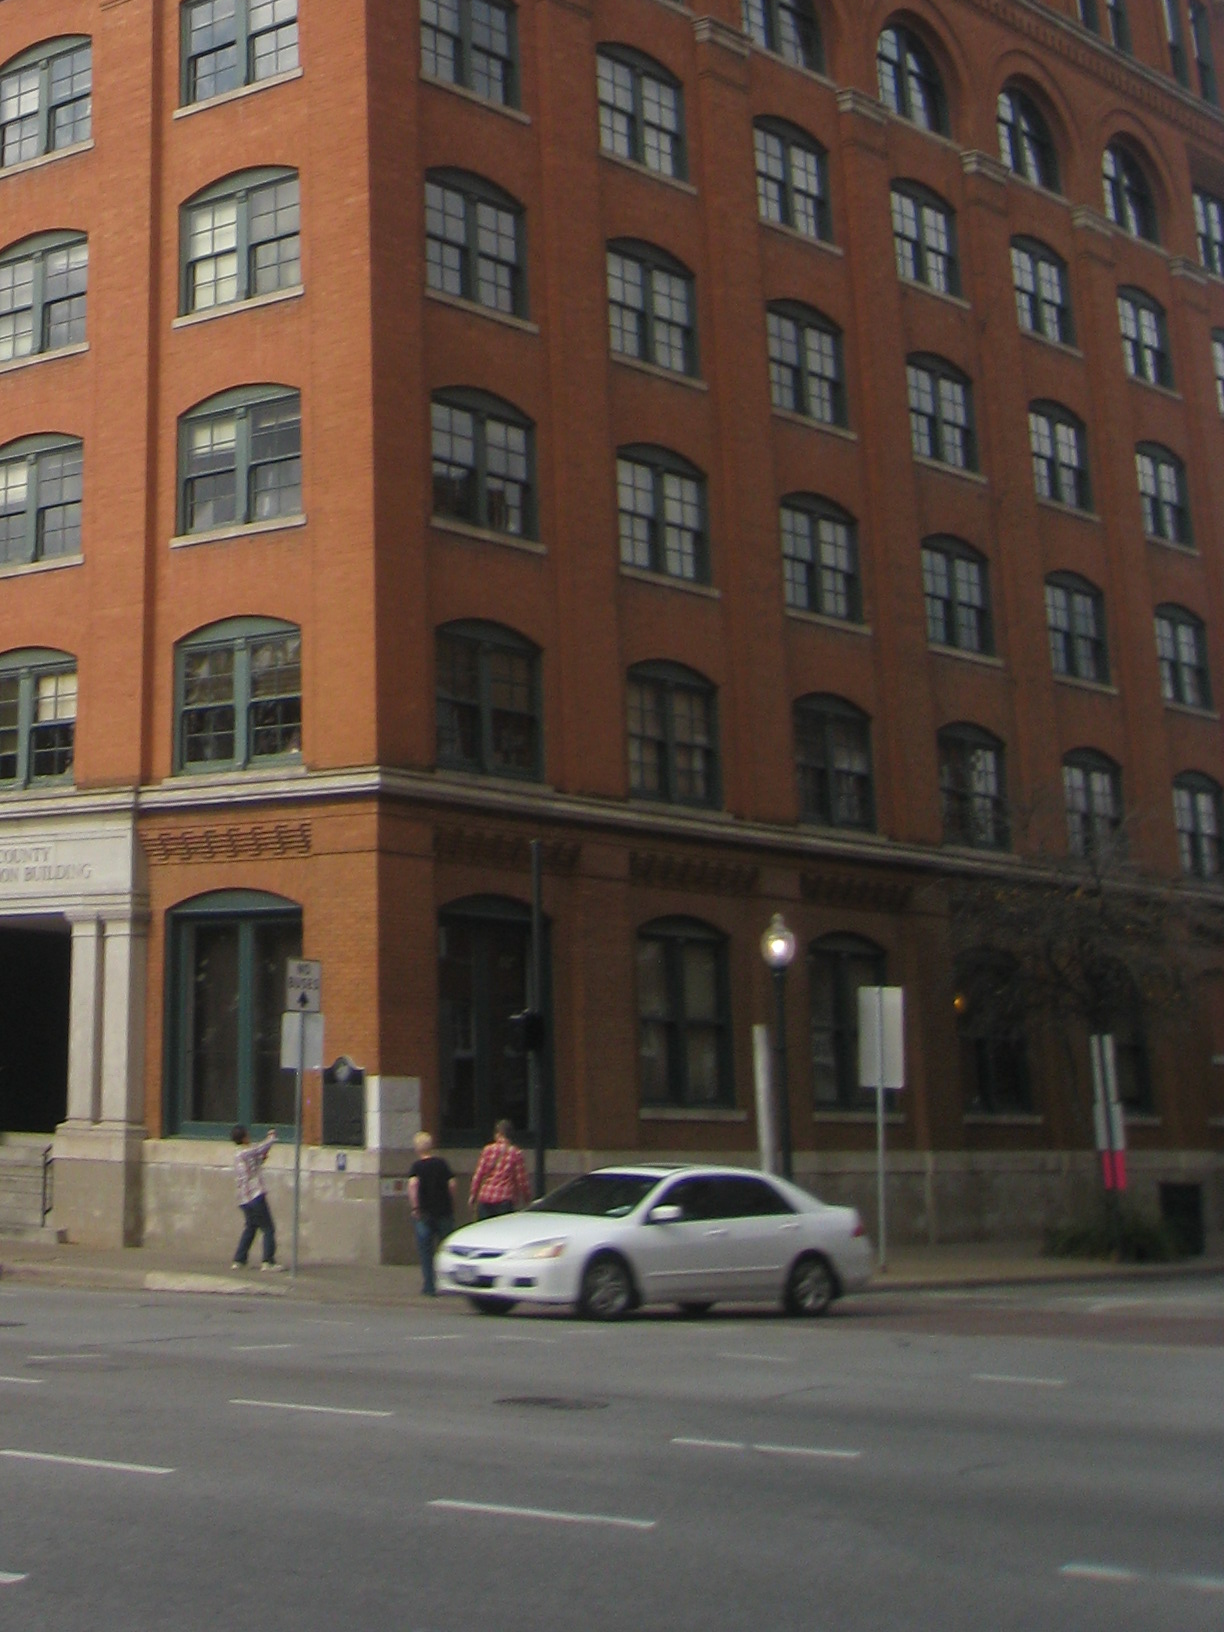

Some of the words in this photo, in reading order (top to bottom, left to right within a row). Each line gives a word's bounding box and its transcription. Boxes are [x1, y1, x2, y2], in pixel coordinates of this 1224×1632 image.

[23, 863, 92, 883] BUILDING
[297, 963, 311, 975] NO
[288, 976, 320, 990] BUSES
